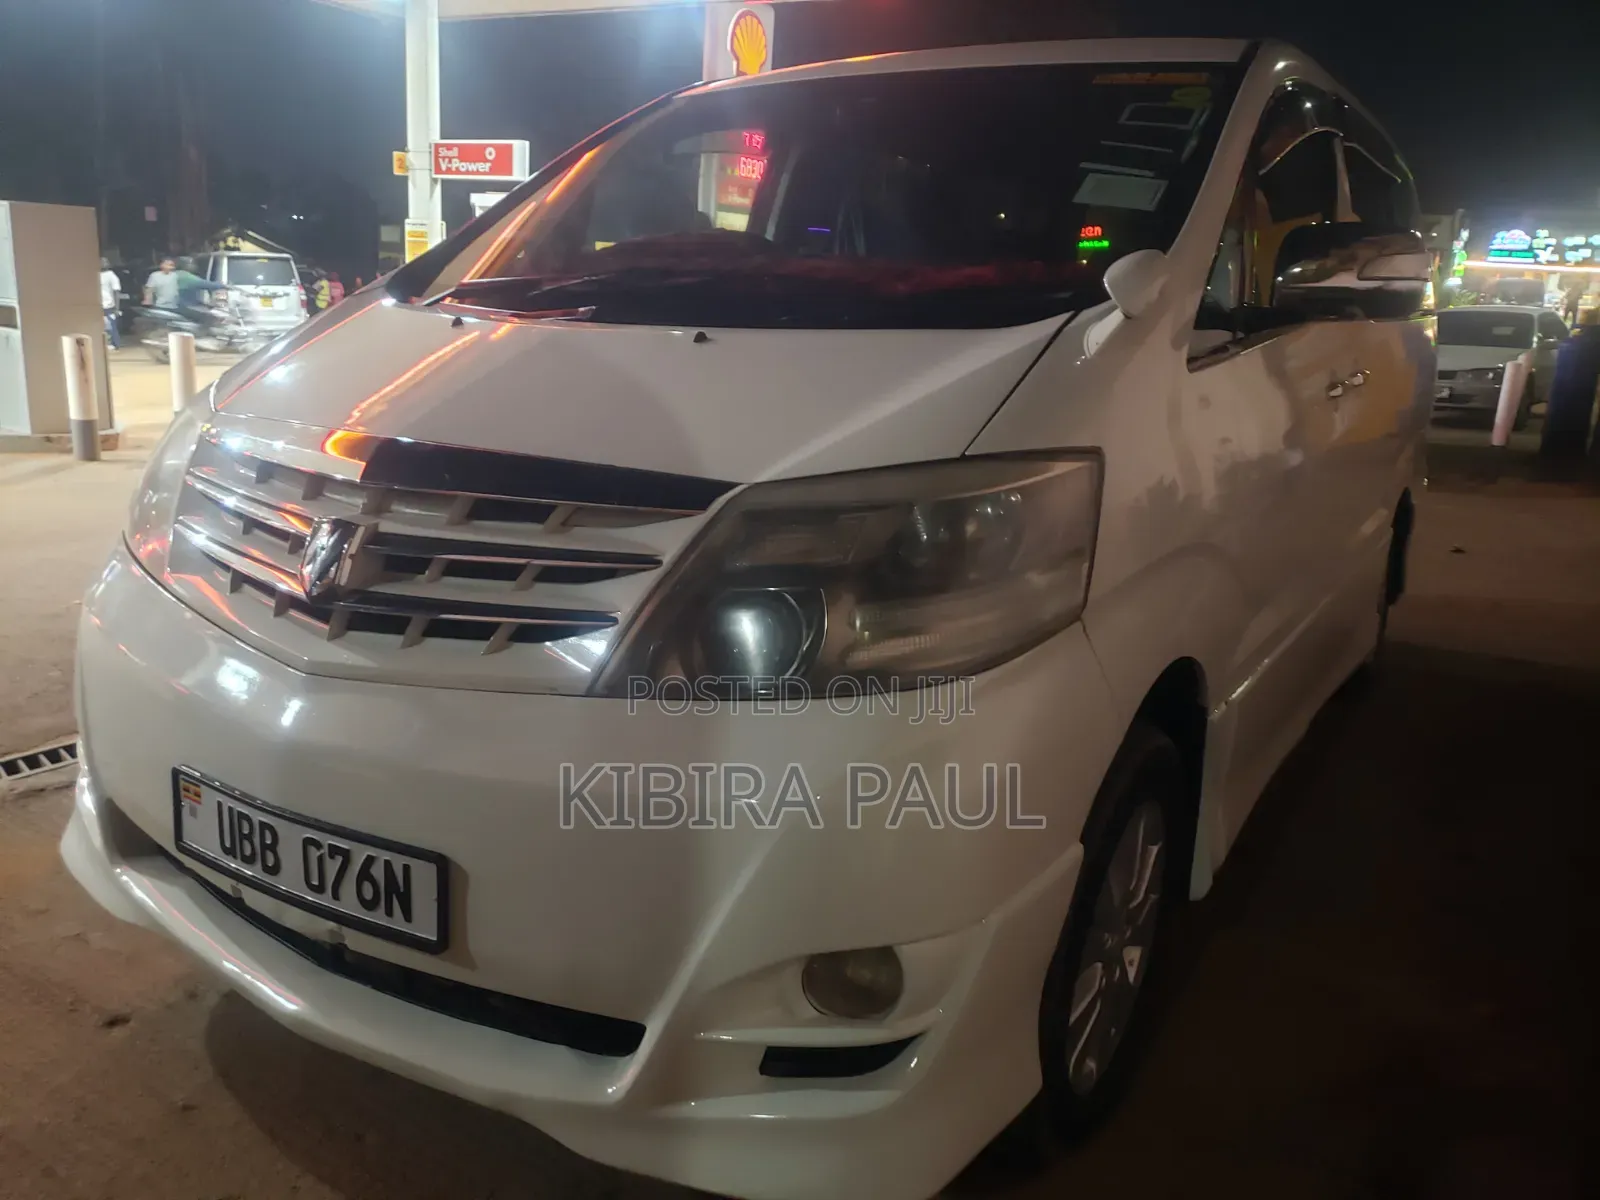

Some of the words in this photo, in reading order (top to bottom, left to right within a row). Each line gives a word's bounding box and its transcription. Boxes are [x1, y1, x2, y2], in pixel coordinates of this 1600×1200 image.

[438, 147, 459, 157] Shell
[438, 158, 492, 172] V-Power
[217, 800, 281, 877] UBB
[302, 835, 412, 924] 076N
